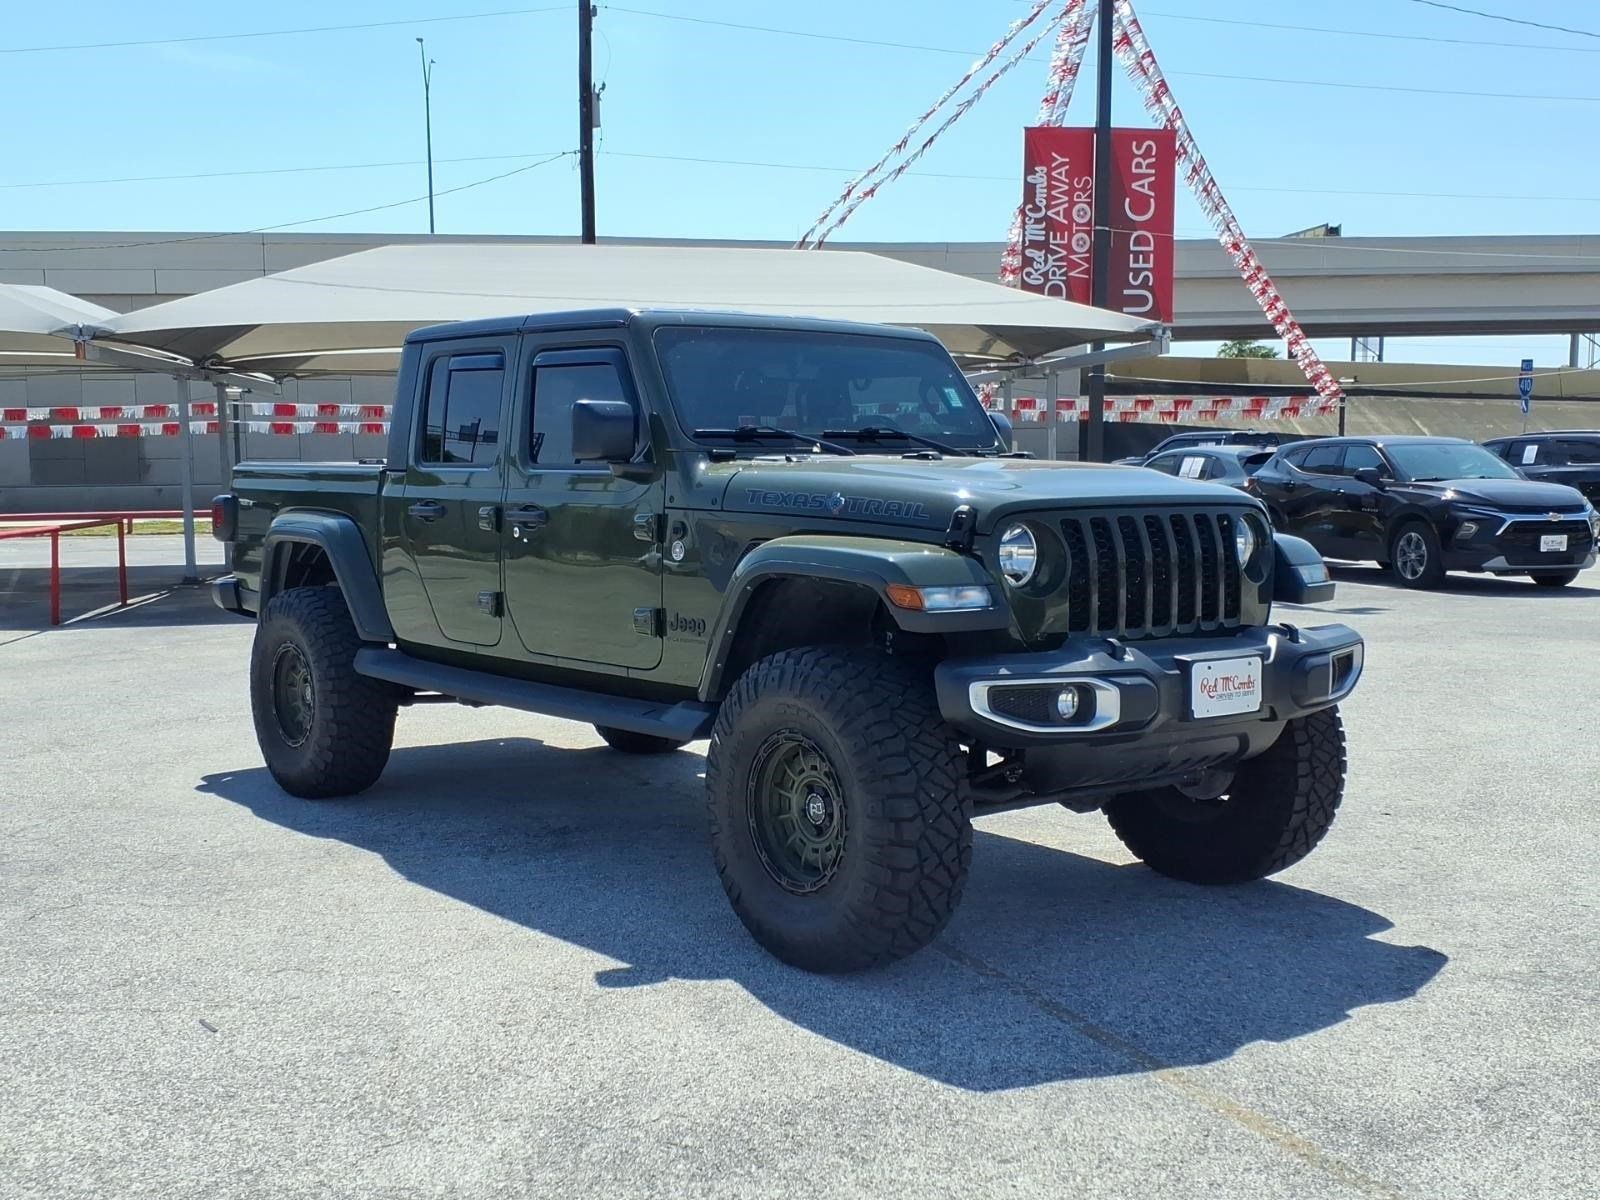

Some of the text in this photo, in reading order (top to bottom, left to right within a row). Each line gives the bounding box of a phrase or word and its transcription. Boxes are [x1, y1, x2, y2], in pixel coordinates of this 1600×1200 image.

[1023, 166, 1050, 286] Red McCombs
[1044, 152, 1070, 300] DRIVE AWAY
[1068, 176, 1092, 279] MOTORS
[1123, 140, 1157, 313] USED CARS
[746, 488, 930, 520] TEXAS TRAIL
[670, 612, 706, 637] Jeep
[1200, 677, 1218, 699] Red
[1220, 674, 1256, 692] McCombs
